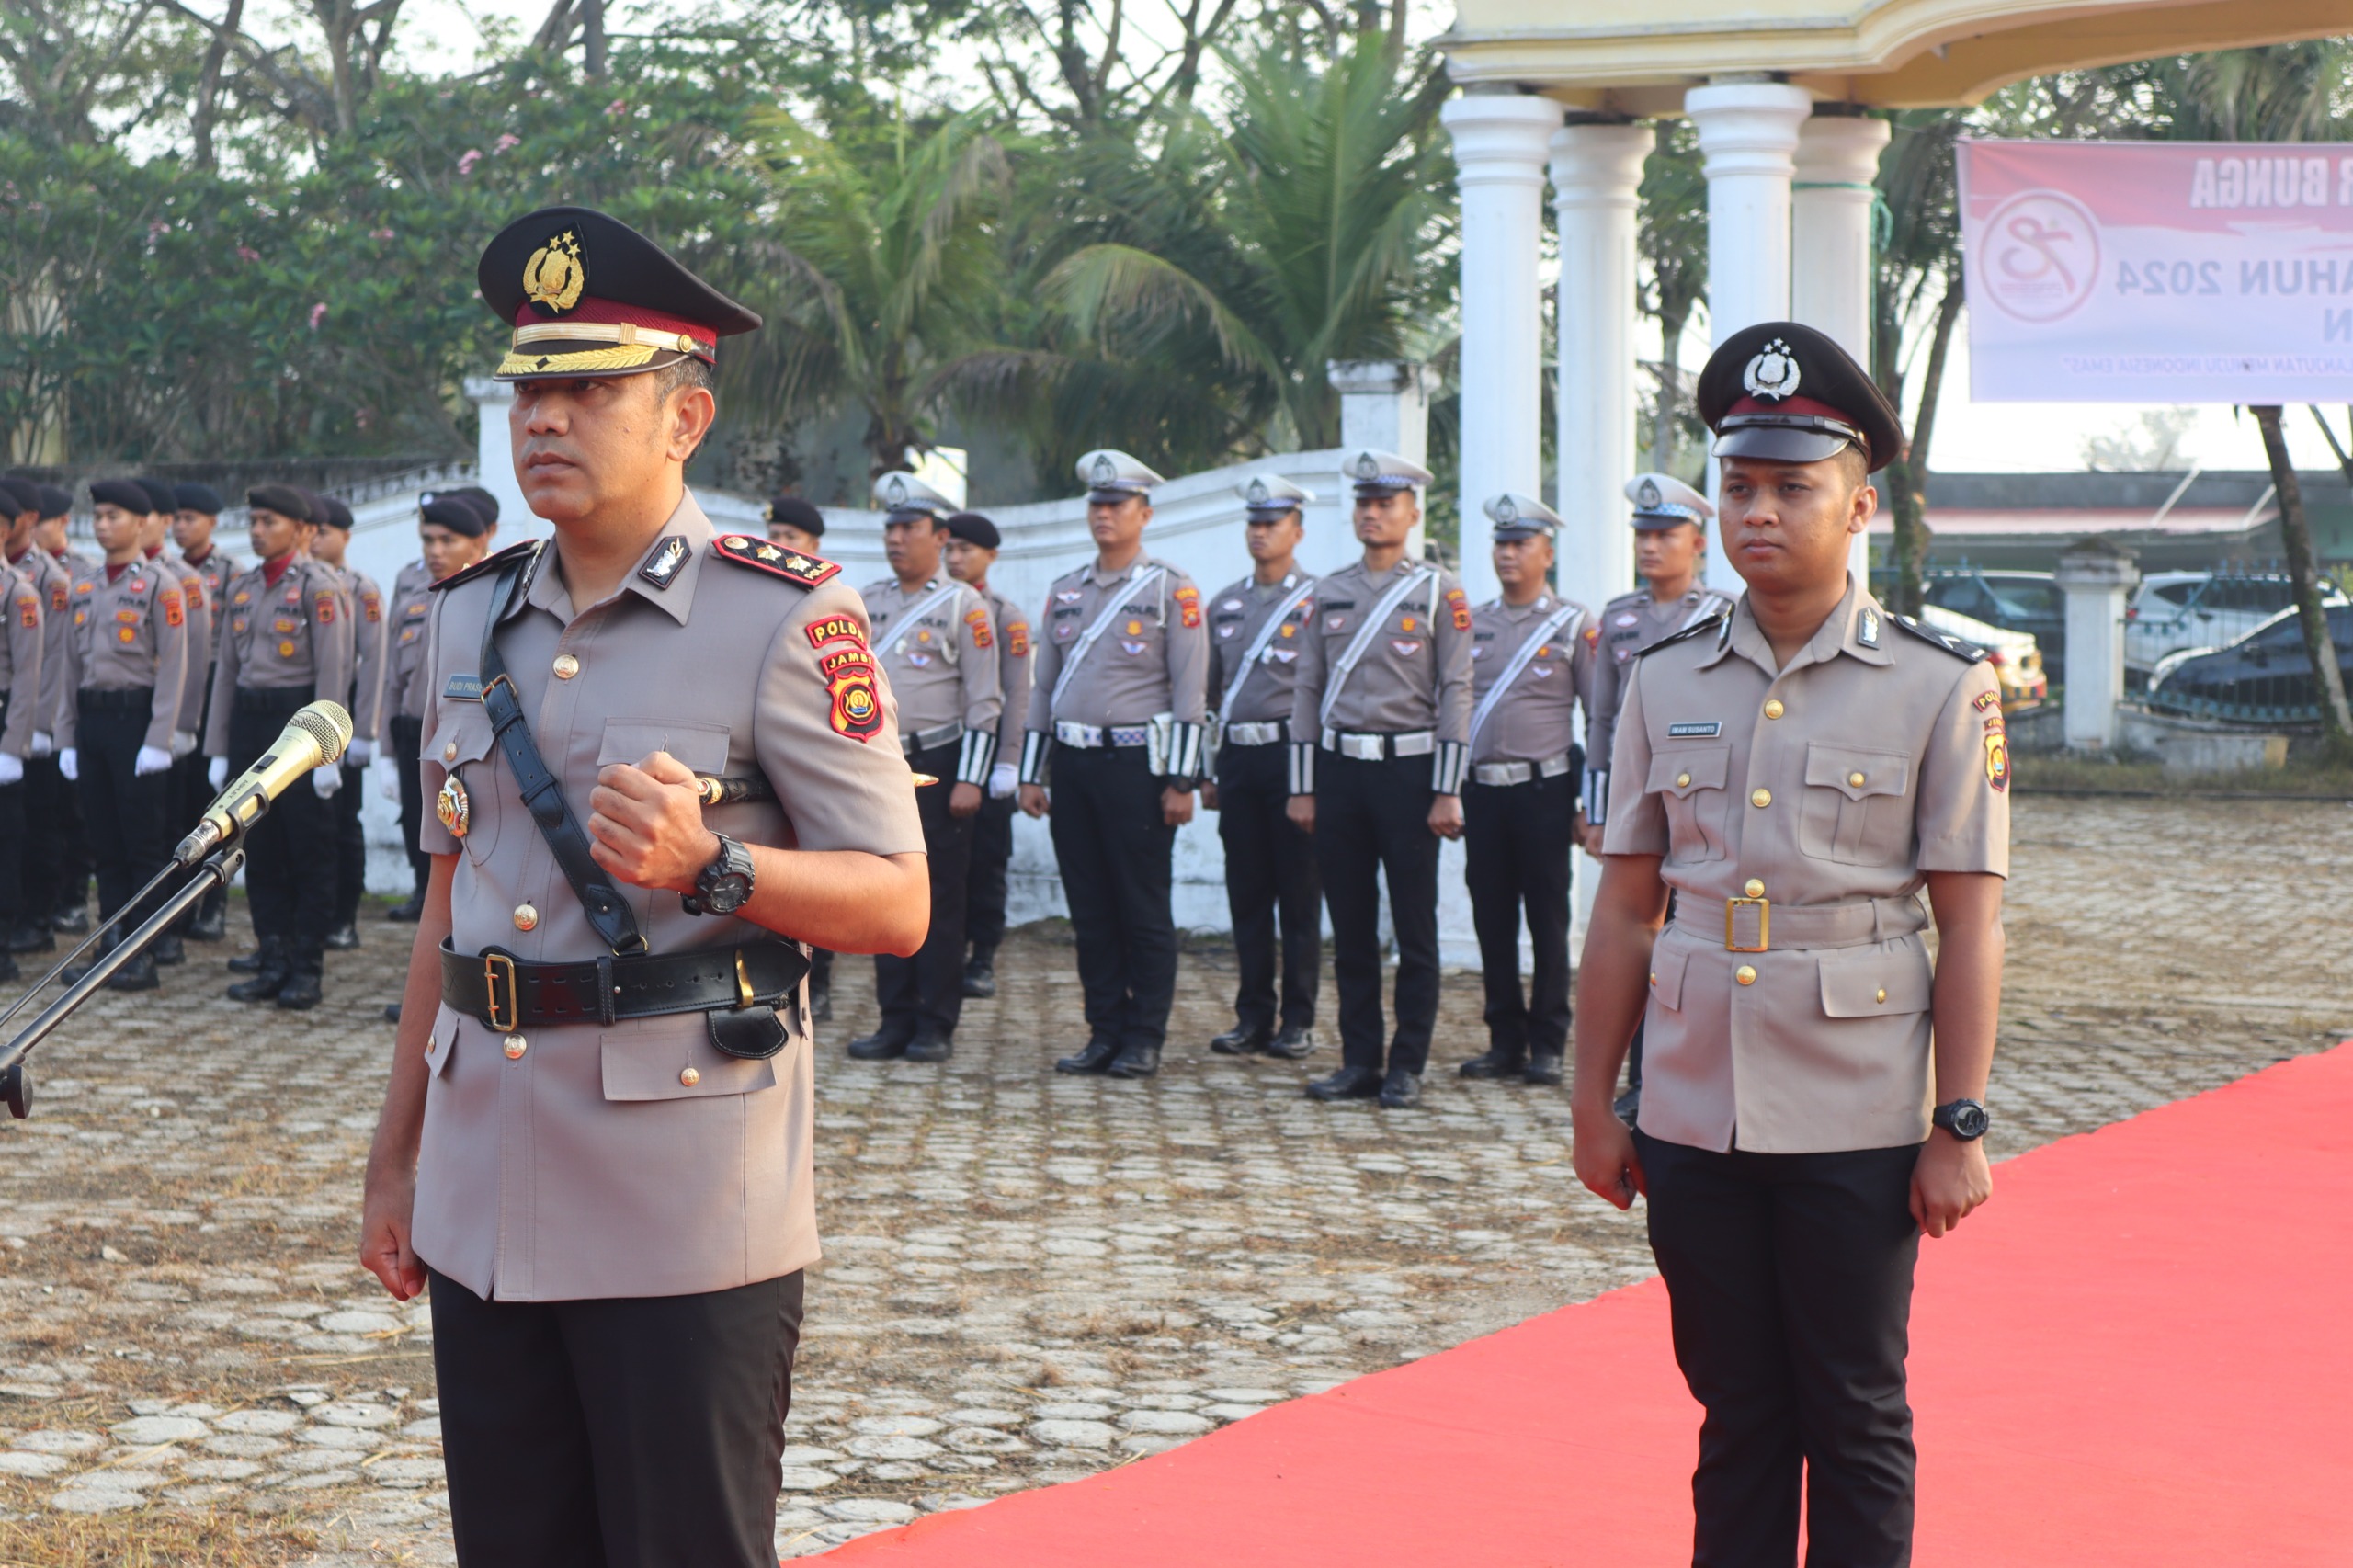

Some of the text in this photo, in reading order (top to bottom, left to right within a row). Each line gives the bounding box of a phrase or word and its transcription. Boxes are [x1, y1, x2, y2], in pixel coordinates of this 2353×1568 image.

[814, 620, 864, 642] POLDA
[829, 652, 872, 669] JAMBI
[1671, 725, 1716, 734] IMAM SUSANTO
